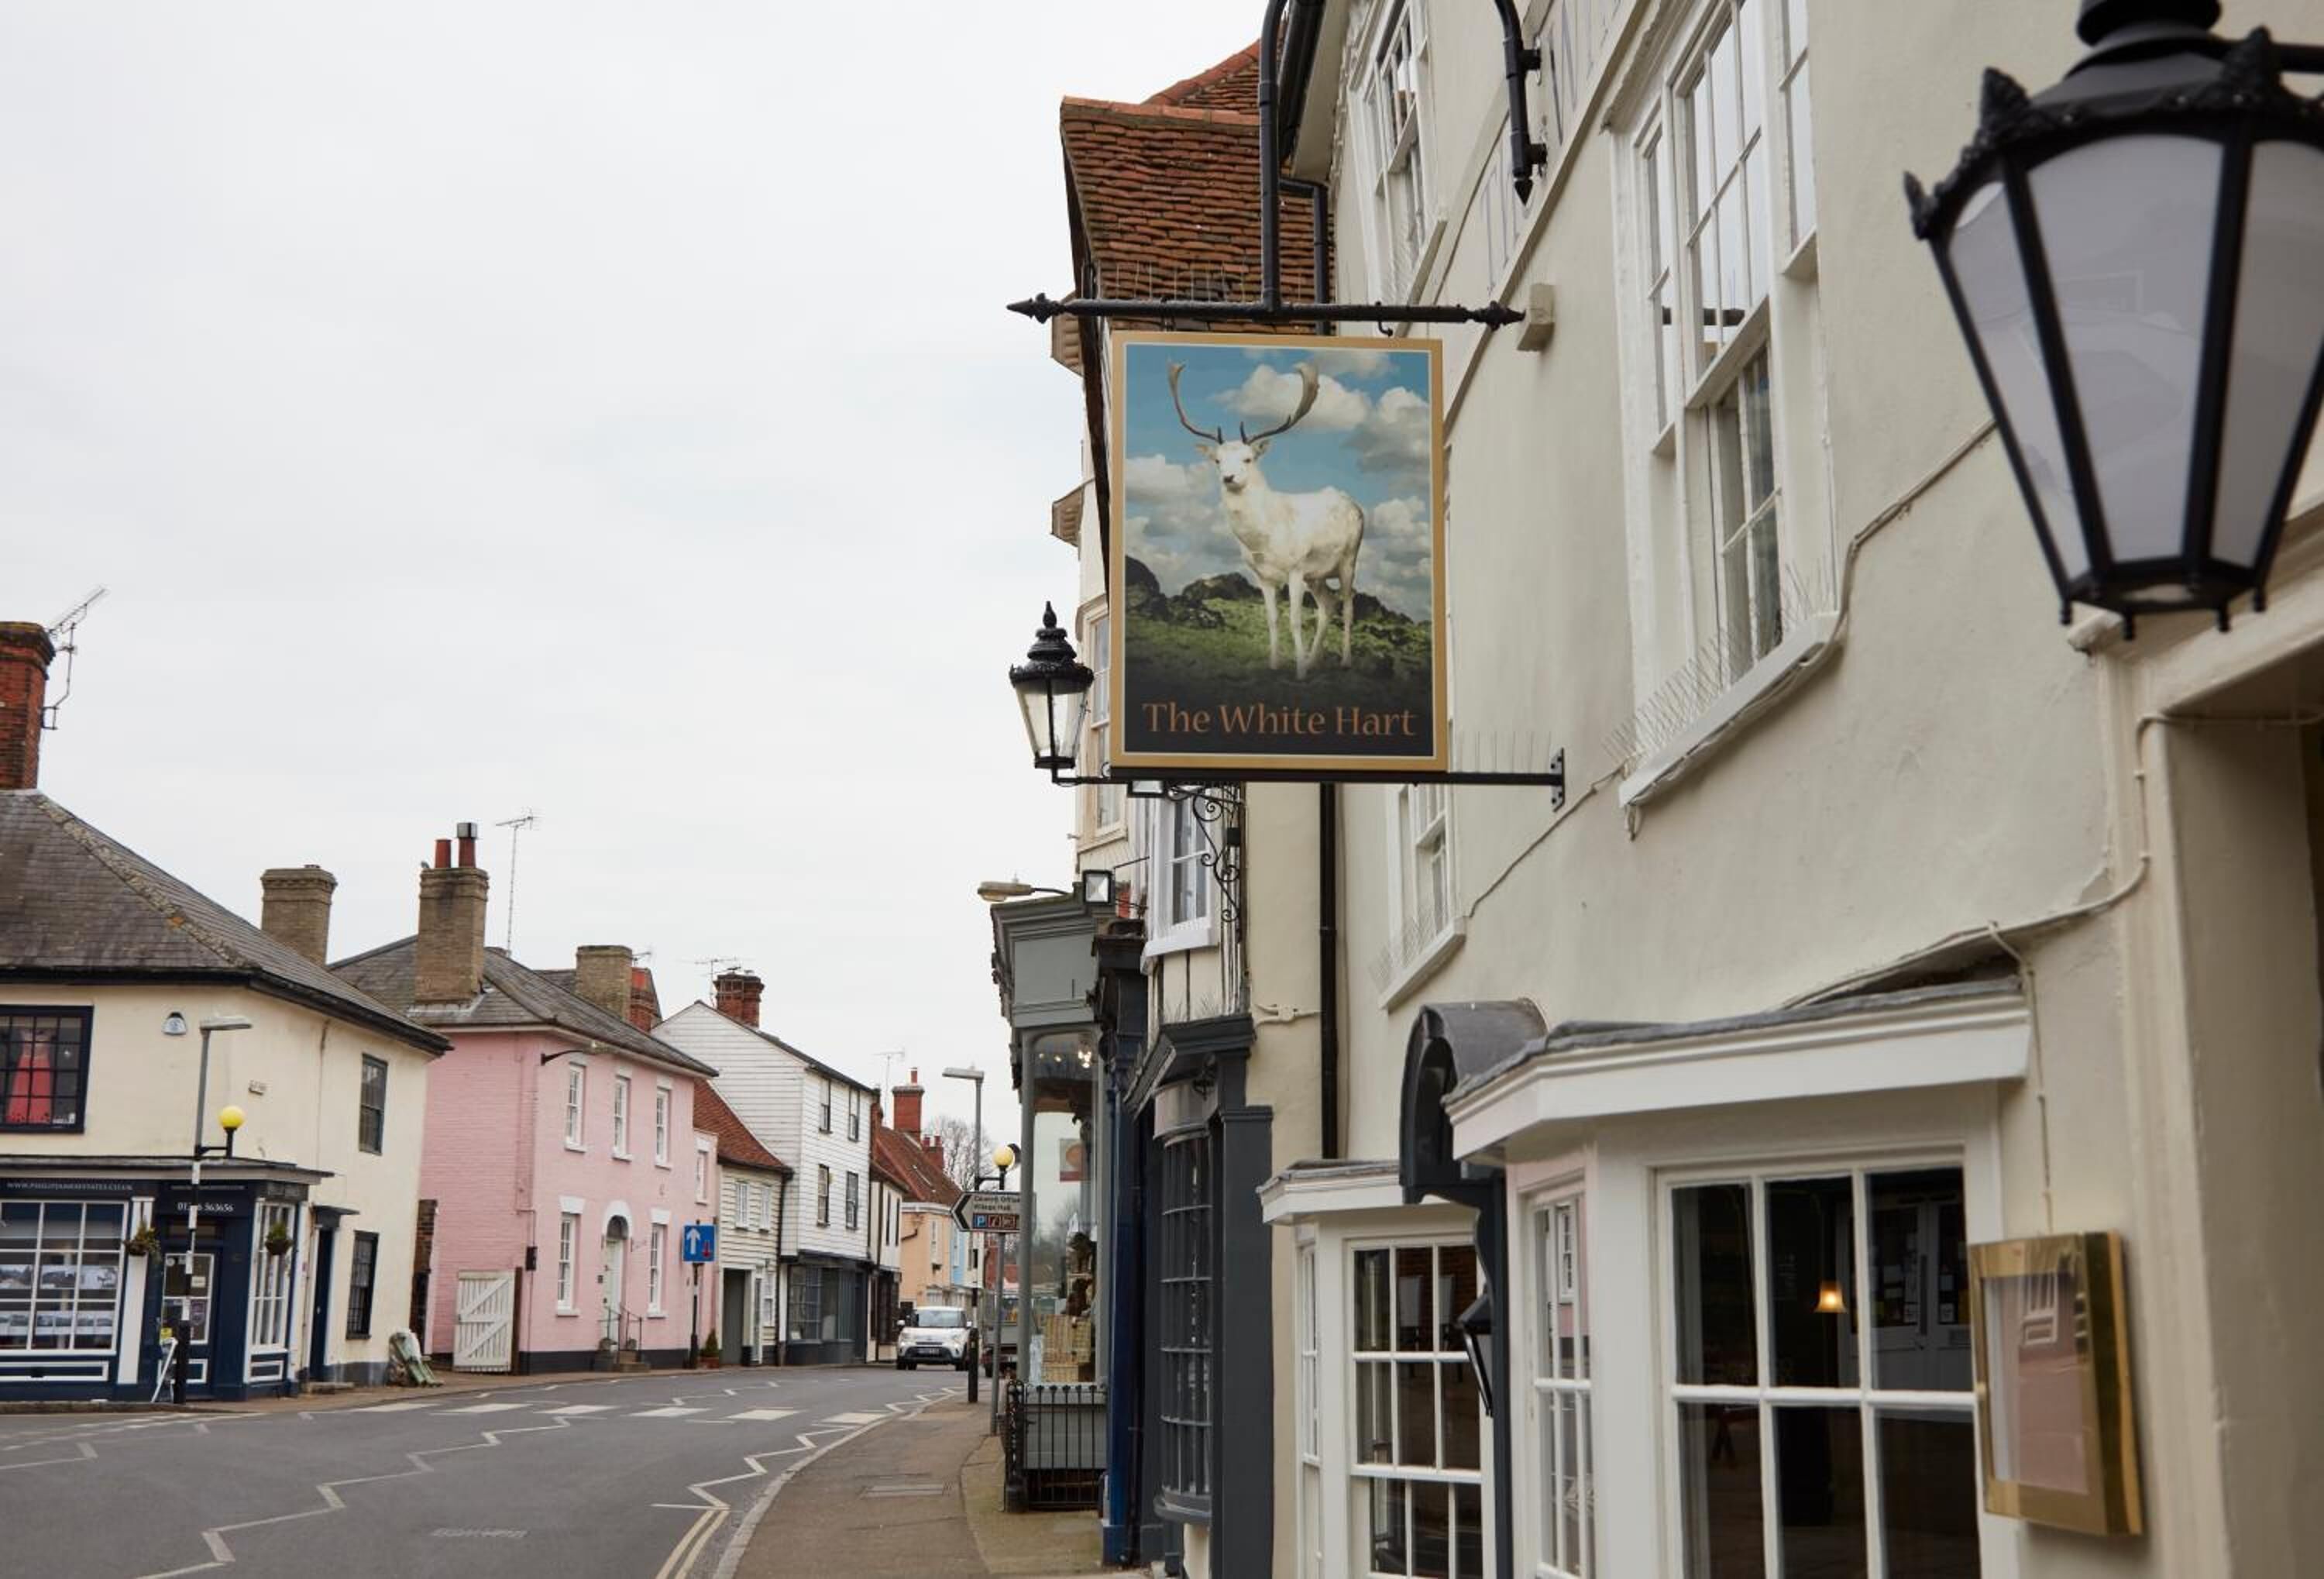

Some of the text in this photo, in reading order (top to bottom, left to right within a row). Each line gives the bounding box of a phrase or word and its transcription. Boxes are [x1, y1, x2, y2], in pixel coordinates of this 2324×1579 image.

[1143, 703, 1418, 737] The White Hart
